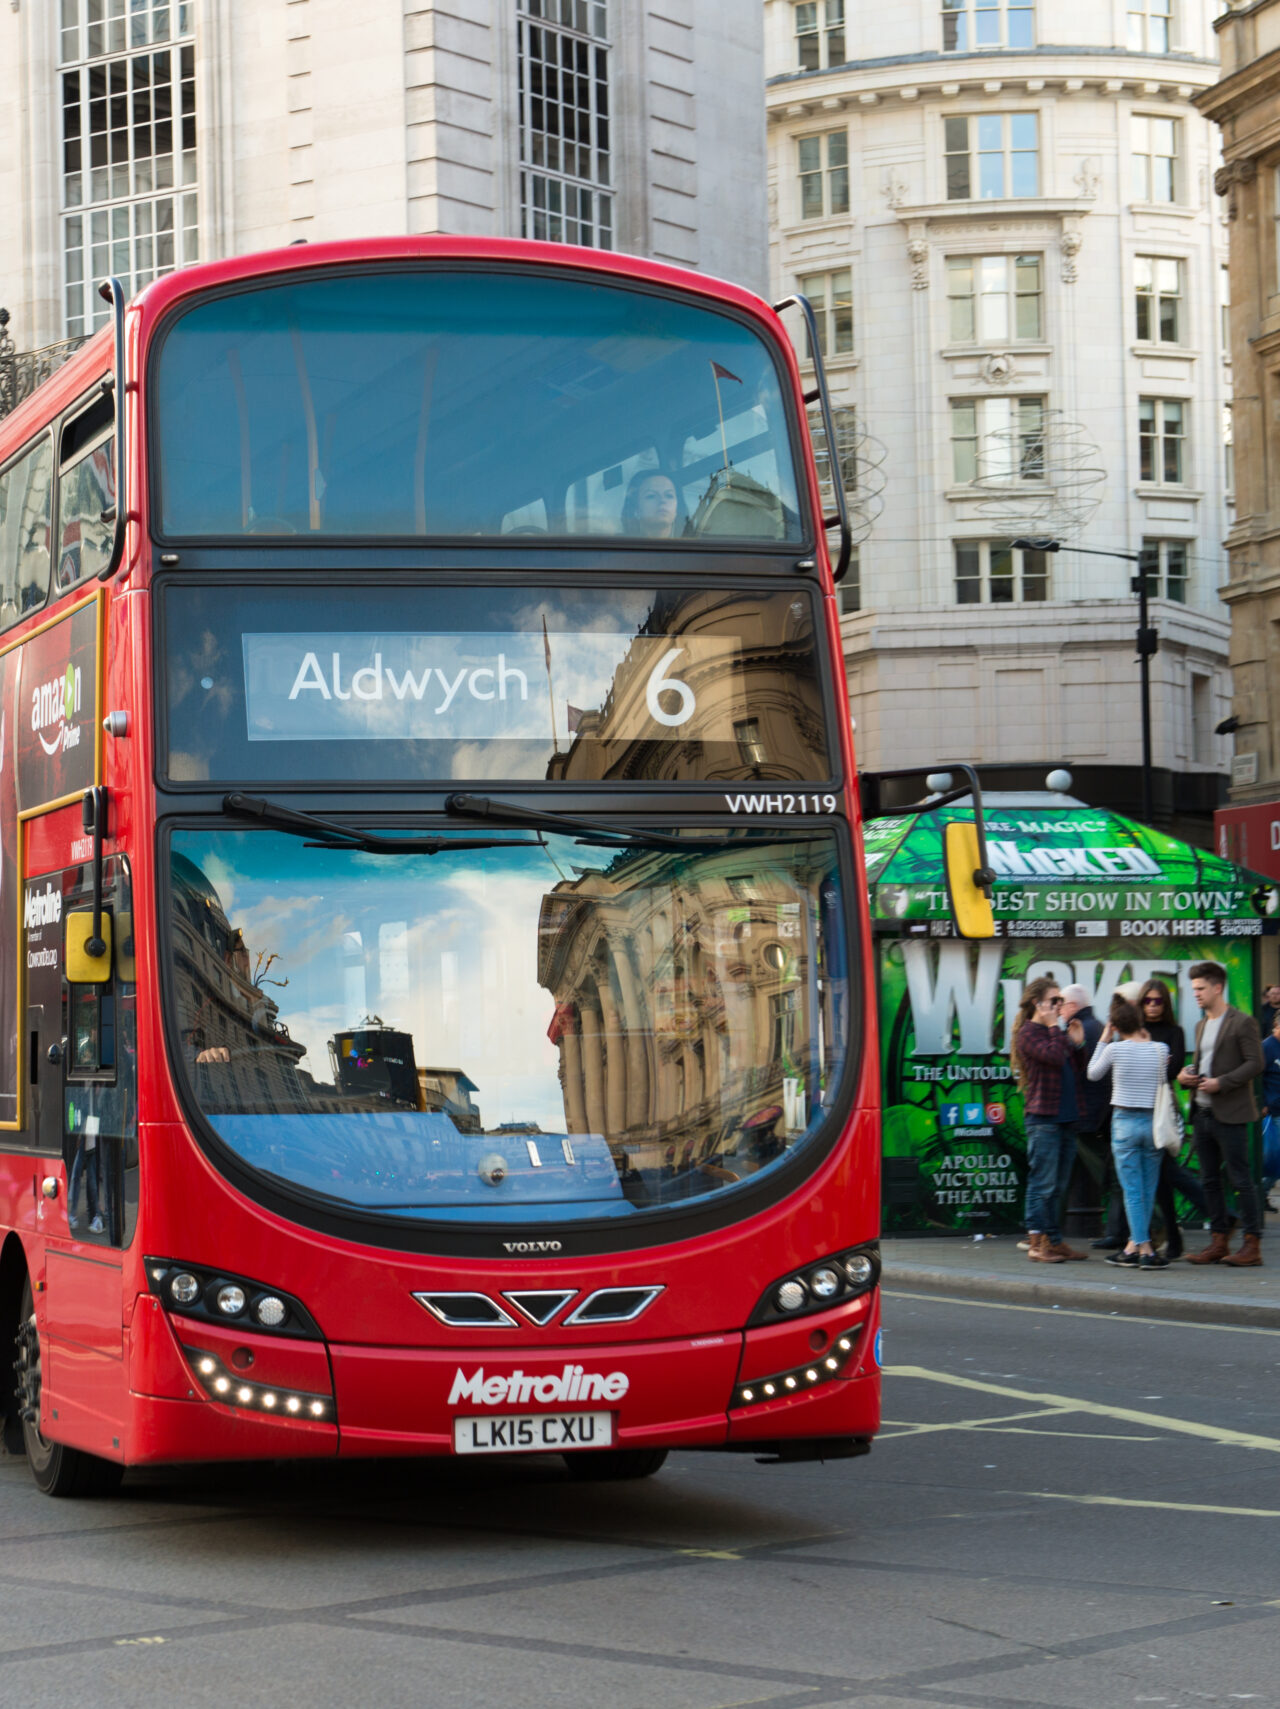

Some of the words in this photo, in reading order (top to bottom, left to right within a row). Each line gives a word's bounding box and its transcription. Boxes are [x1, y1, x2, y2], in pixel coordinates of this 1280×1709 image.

[288, 651, 529, 714] Aldwych
[645, 648, 697, 727] 6
[724, 794, 837, 815] VWH2119
[24, 883, 62, 929] Metroline
[1046, 892, 1119, 911] SHOW
[1125, 892, 1152, 911] IN
[1121, 920, 1170, 936] BOOK
[1172, 920, 1216, 935] HERE
[912, 1065, 943, 1080] THE
[946, 1065, 1011, 1080] UNTOLD
[940, 1154, 1011, 1169] APOLLO
[932, 1171, 1019, 1186] VICTORIA
[934, 1189, 1017, 1204] THEATRE
[503, 1240, 562, 1253] VOLVO
[447, 1365, 630, 1405] Metroline
[472, 1418, 533, 1447] LK15
[541, 1416, 595, 1442] CXU
